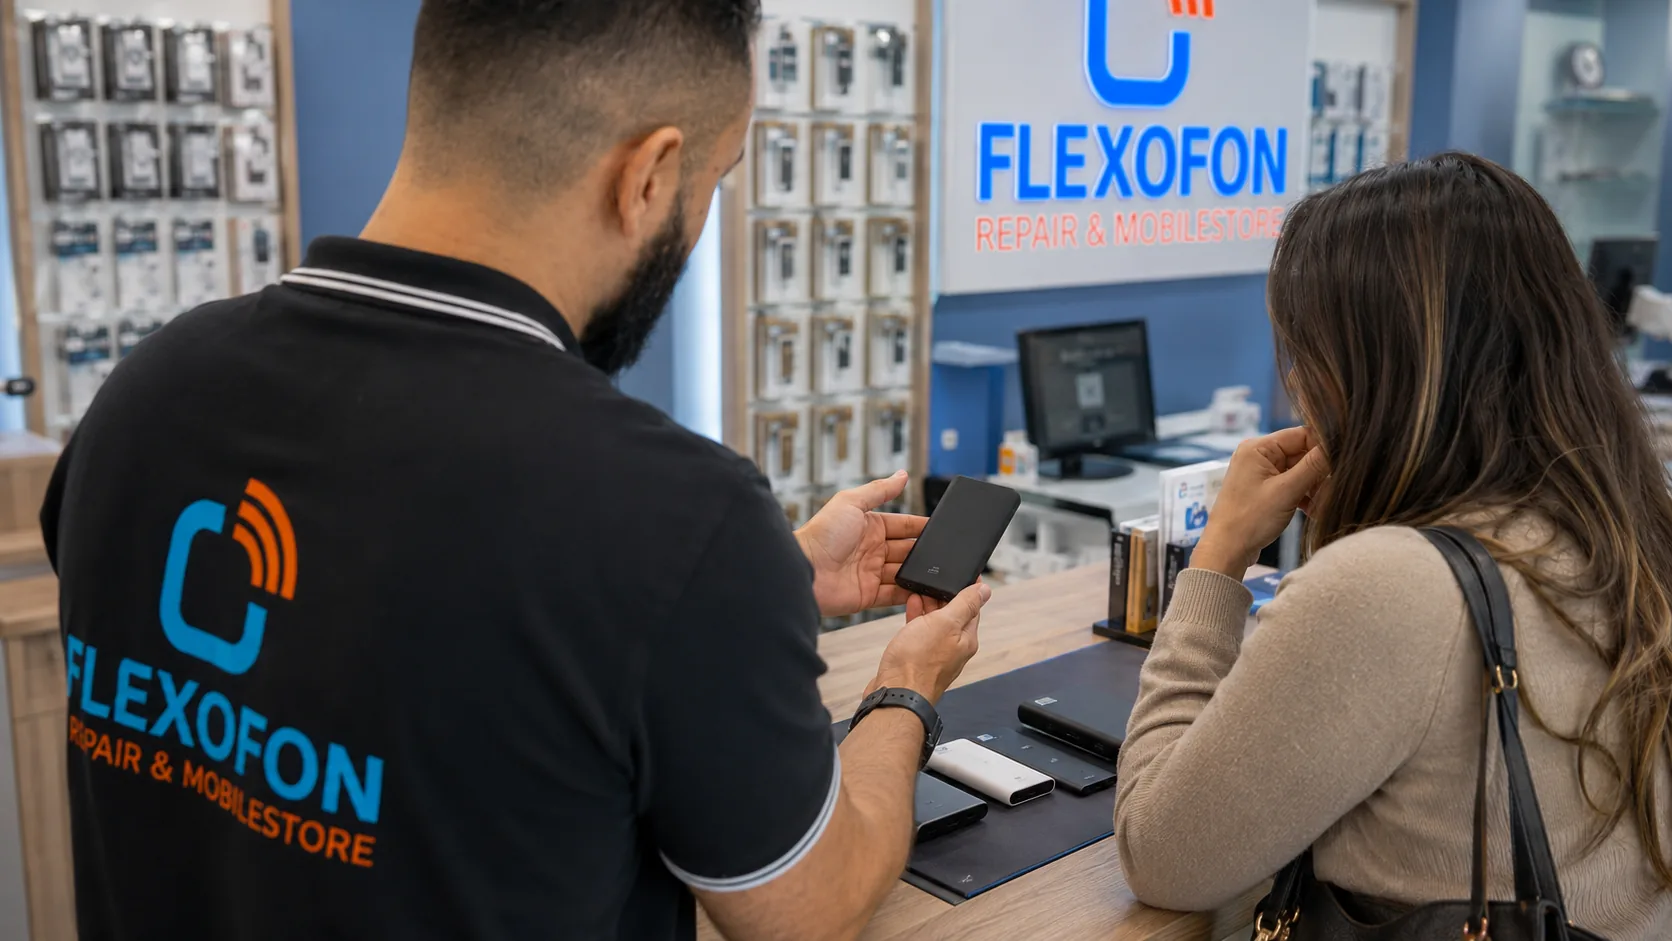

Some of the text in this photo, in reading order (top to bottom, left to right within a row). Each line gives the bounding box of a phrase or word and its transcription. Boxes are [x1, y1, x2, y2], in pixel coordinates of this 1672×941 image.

[977, 121, 1289, 202] FLEXOFON
[975, 206, 1284, 252] REPAIR & MOBILESTORE
[67, 634, 384, 824] FLEXOFON
[149, 750, 174, 783] &
[182, 759, 377, 868] MOBILESTORE
